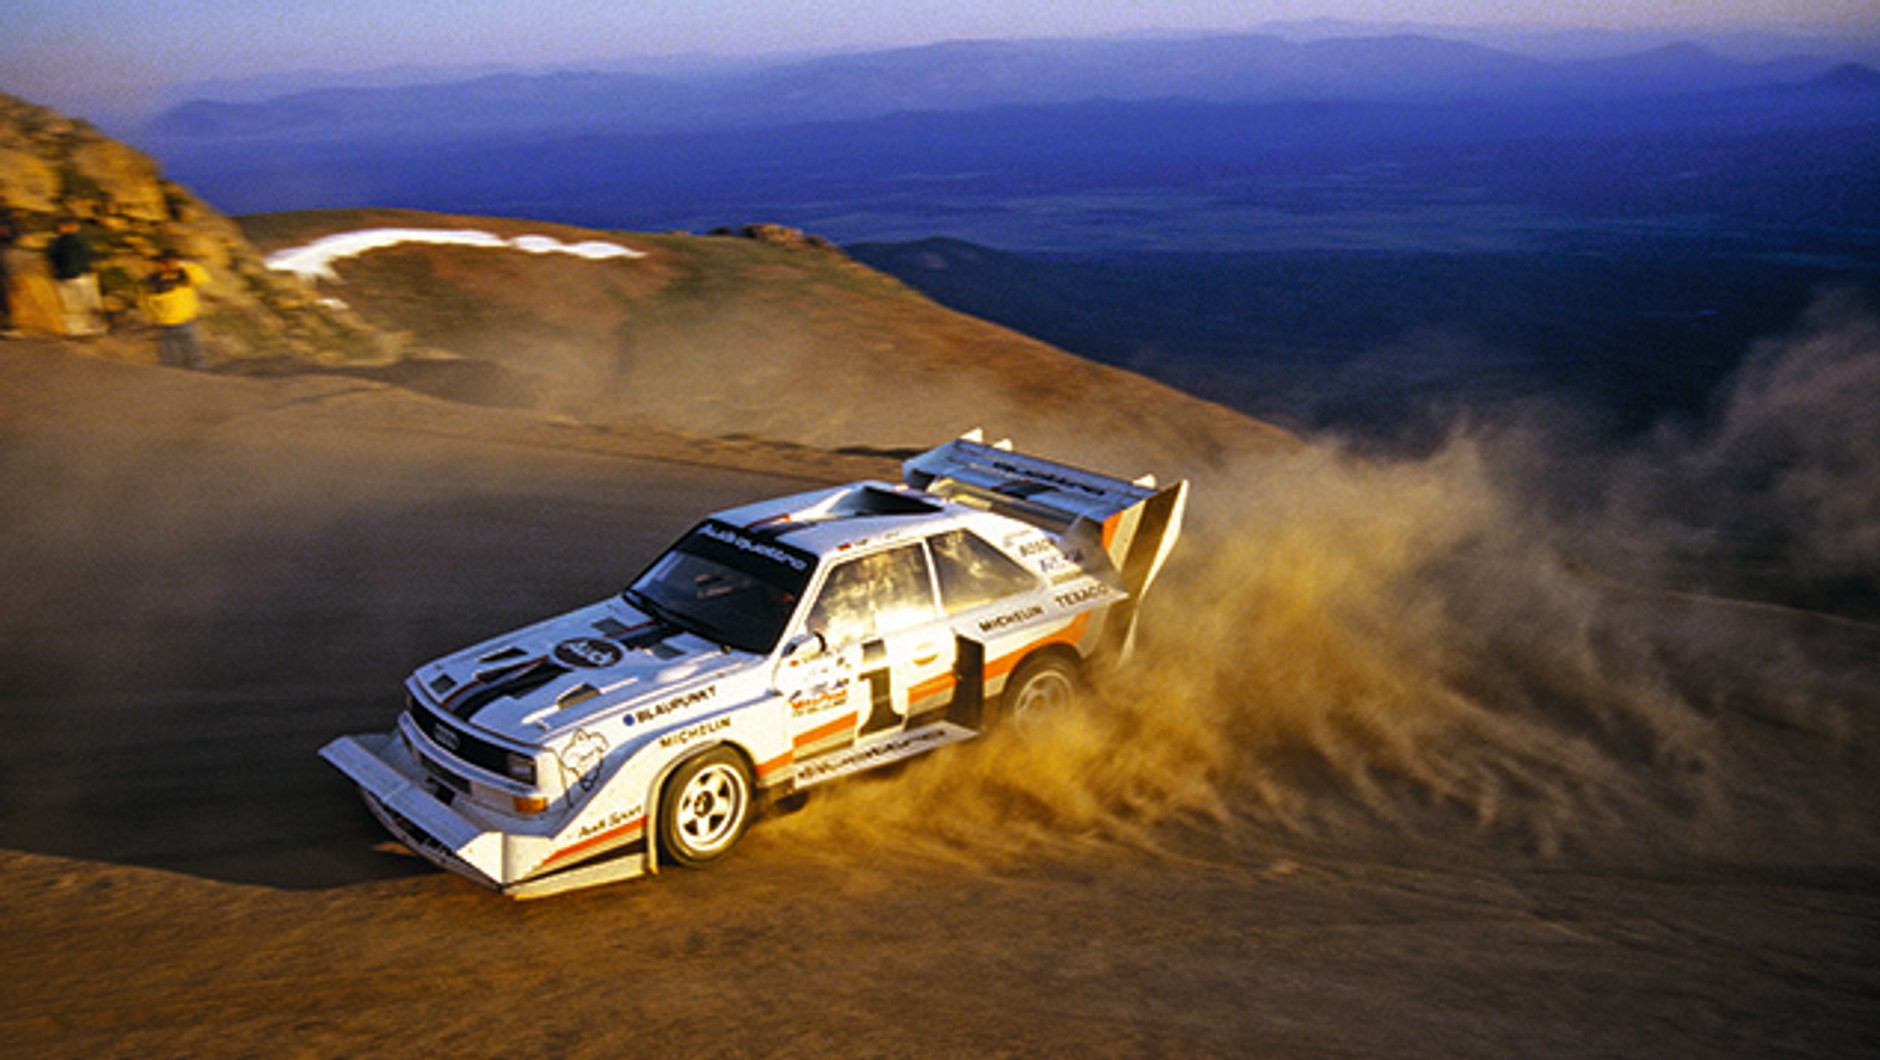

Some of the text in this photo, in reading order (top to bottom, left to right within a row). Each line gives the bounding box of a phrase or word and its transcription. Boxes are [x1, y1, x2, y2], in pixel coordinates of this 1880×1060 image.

[979, 605, 1044, 632] MICHELIN
[635, 684, 716, 724] BLAUPUNKT
[659, 716, 731, 748] MICHELIN
